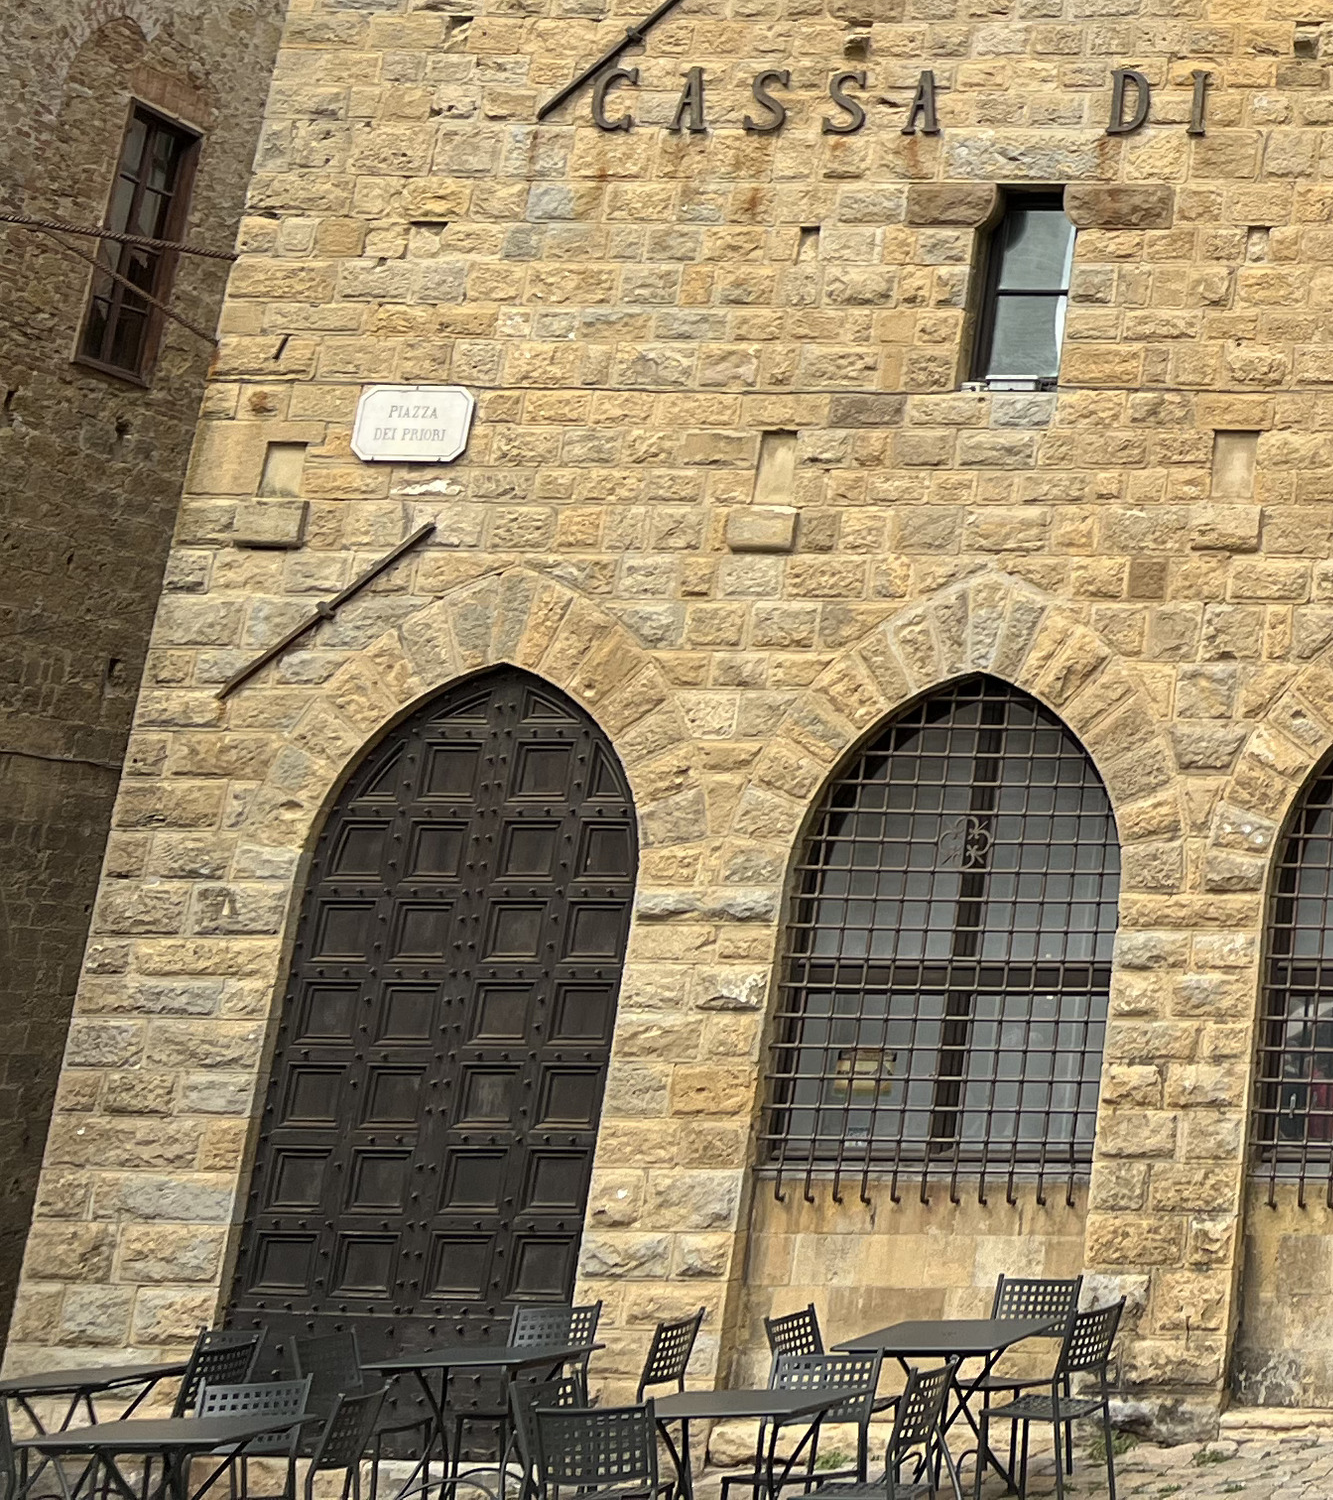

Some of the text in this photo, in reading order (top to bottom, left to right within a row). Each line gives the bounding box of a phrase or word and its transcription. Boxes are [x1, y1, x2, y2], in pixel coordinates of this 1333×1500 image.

[590, 66, 942, 135] CASSA
[1104, 68, 1211, 137] DI
[388, 405, 438, 419] PIAZZA
[373, 427, 447, 442] DEI PRIORI
